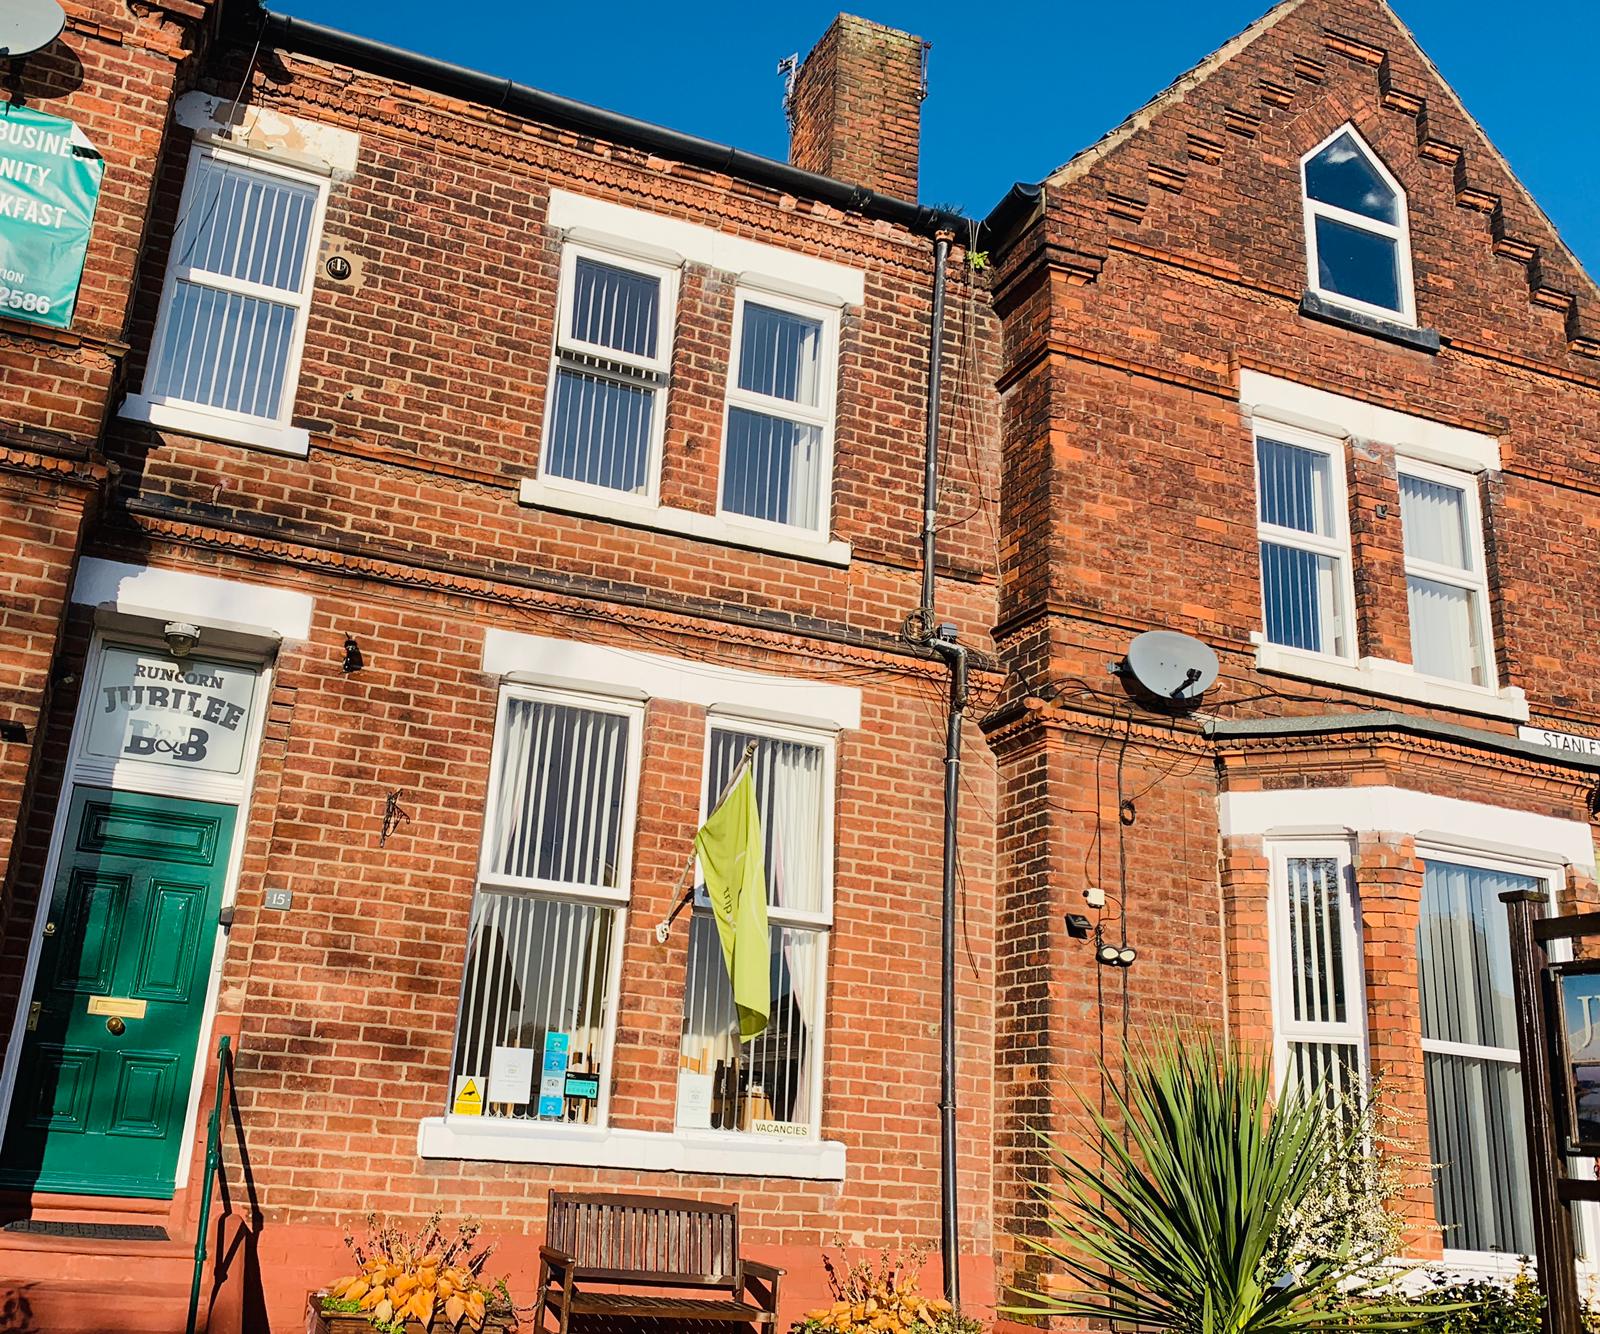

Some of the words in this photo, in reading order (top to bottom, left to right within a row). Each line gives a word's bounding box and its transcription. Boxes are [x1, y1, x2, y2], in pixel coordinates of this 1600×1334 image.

[0, 119, 98, 163] BUSINE
[0, 269, 25, 284] ION
[133, 664, 225, 689] RUNCORN
[103, 685, 246, 731] JUBILEE
[124, 719, 209, 762] B&B
[272, 893, 286, 905] 15
[1576, 995, 1600, 1051] J
[755, 1122, 808, 1136] VACANCIES
